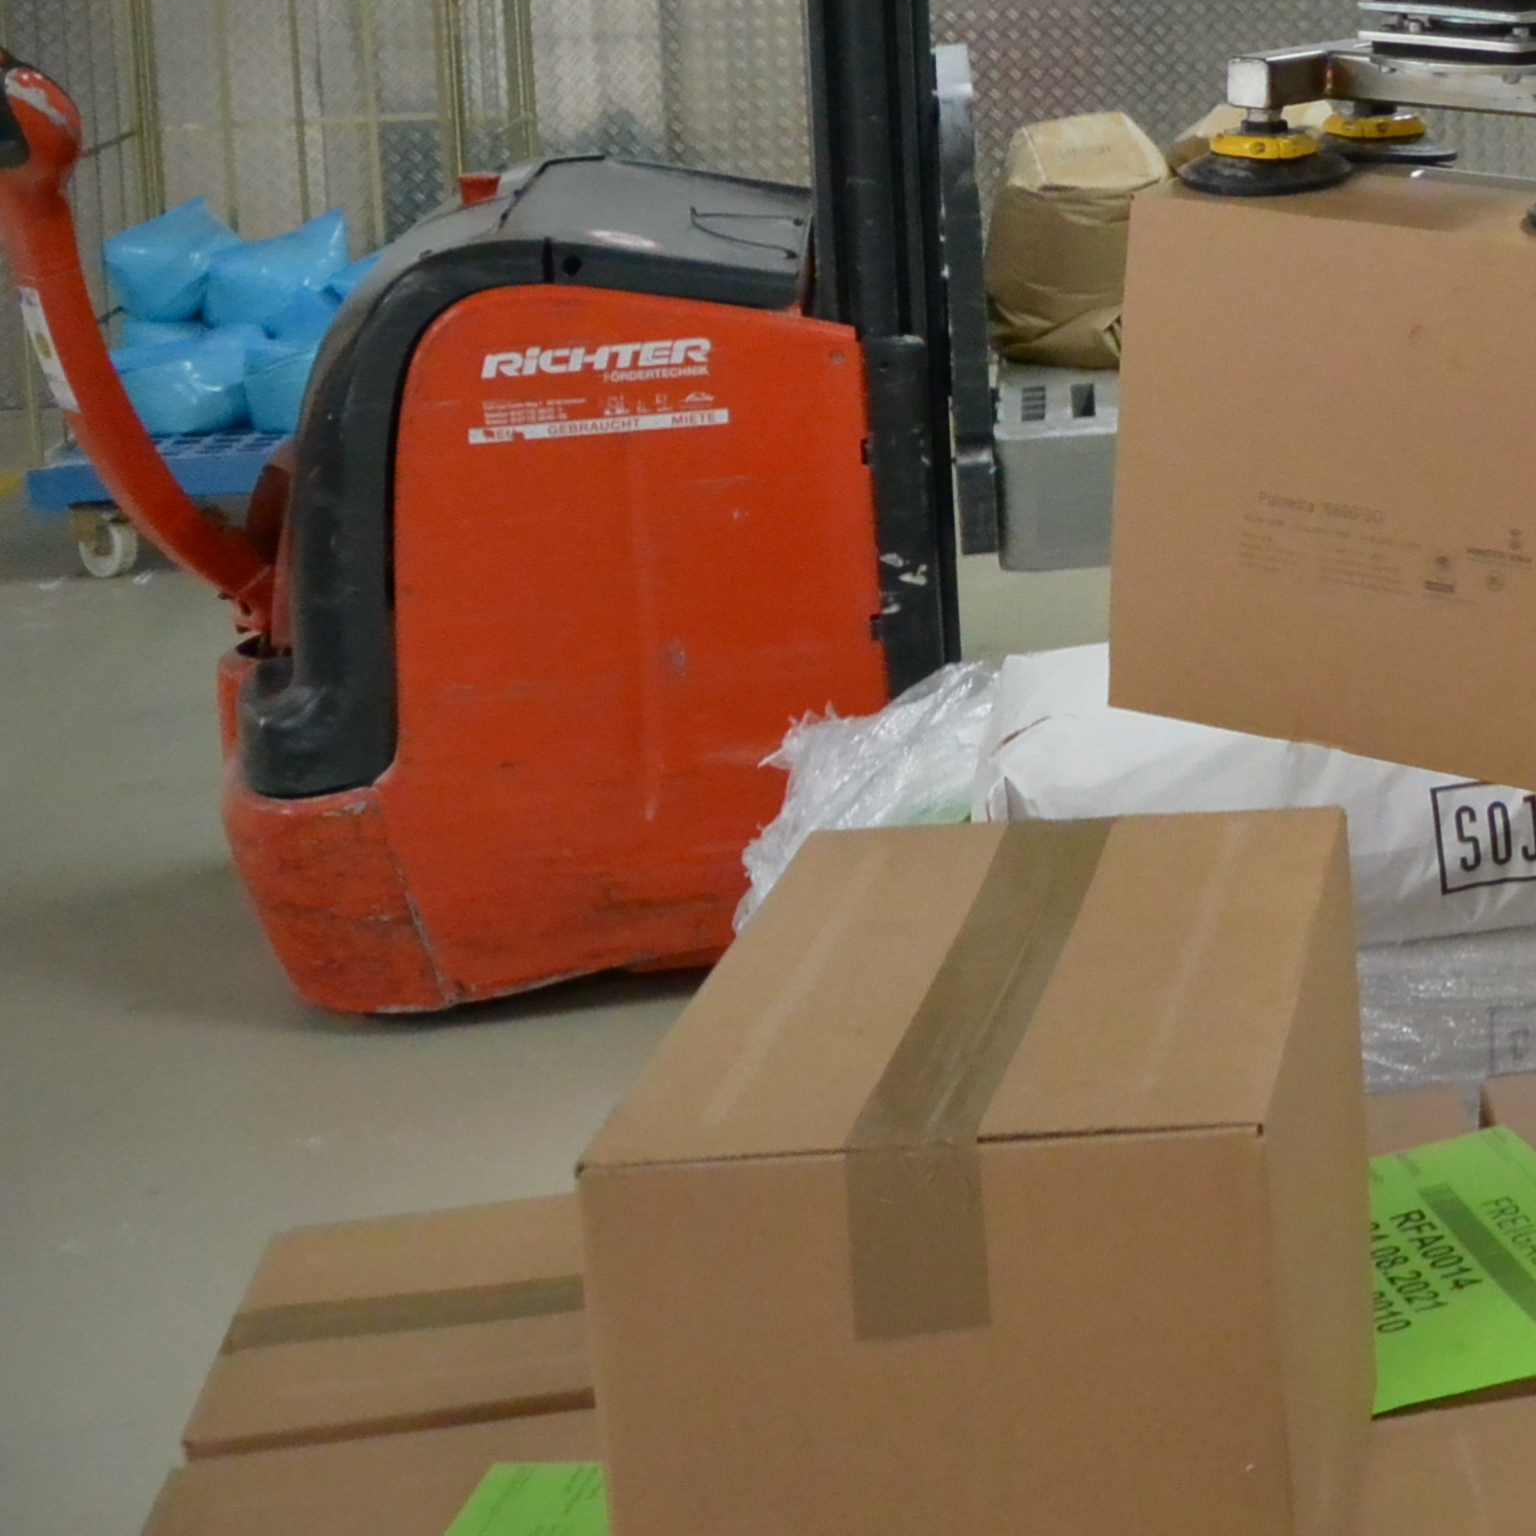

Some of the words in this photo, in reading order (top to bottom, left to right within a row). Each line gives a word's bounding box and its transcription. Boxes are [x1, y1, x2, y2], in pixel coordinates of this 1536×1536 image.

[546, 417, 641, 437] GEBRAUCHT
[670, 411, 717, 426] MIETE
[1388, 1208, 1484, 1291] RFA0014
